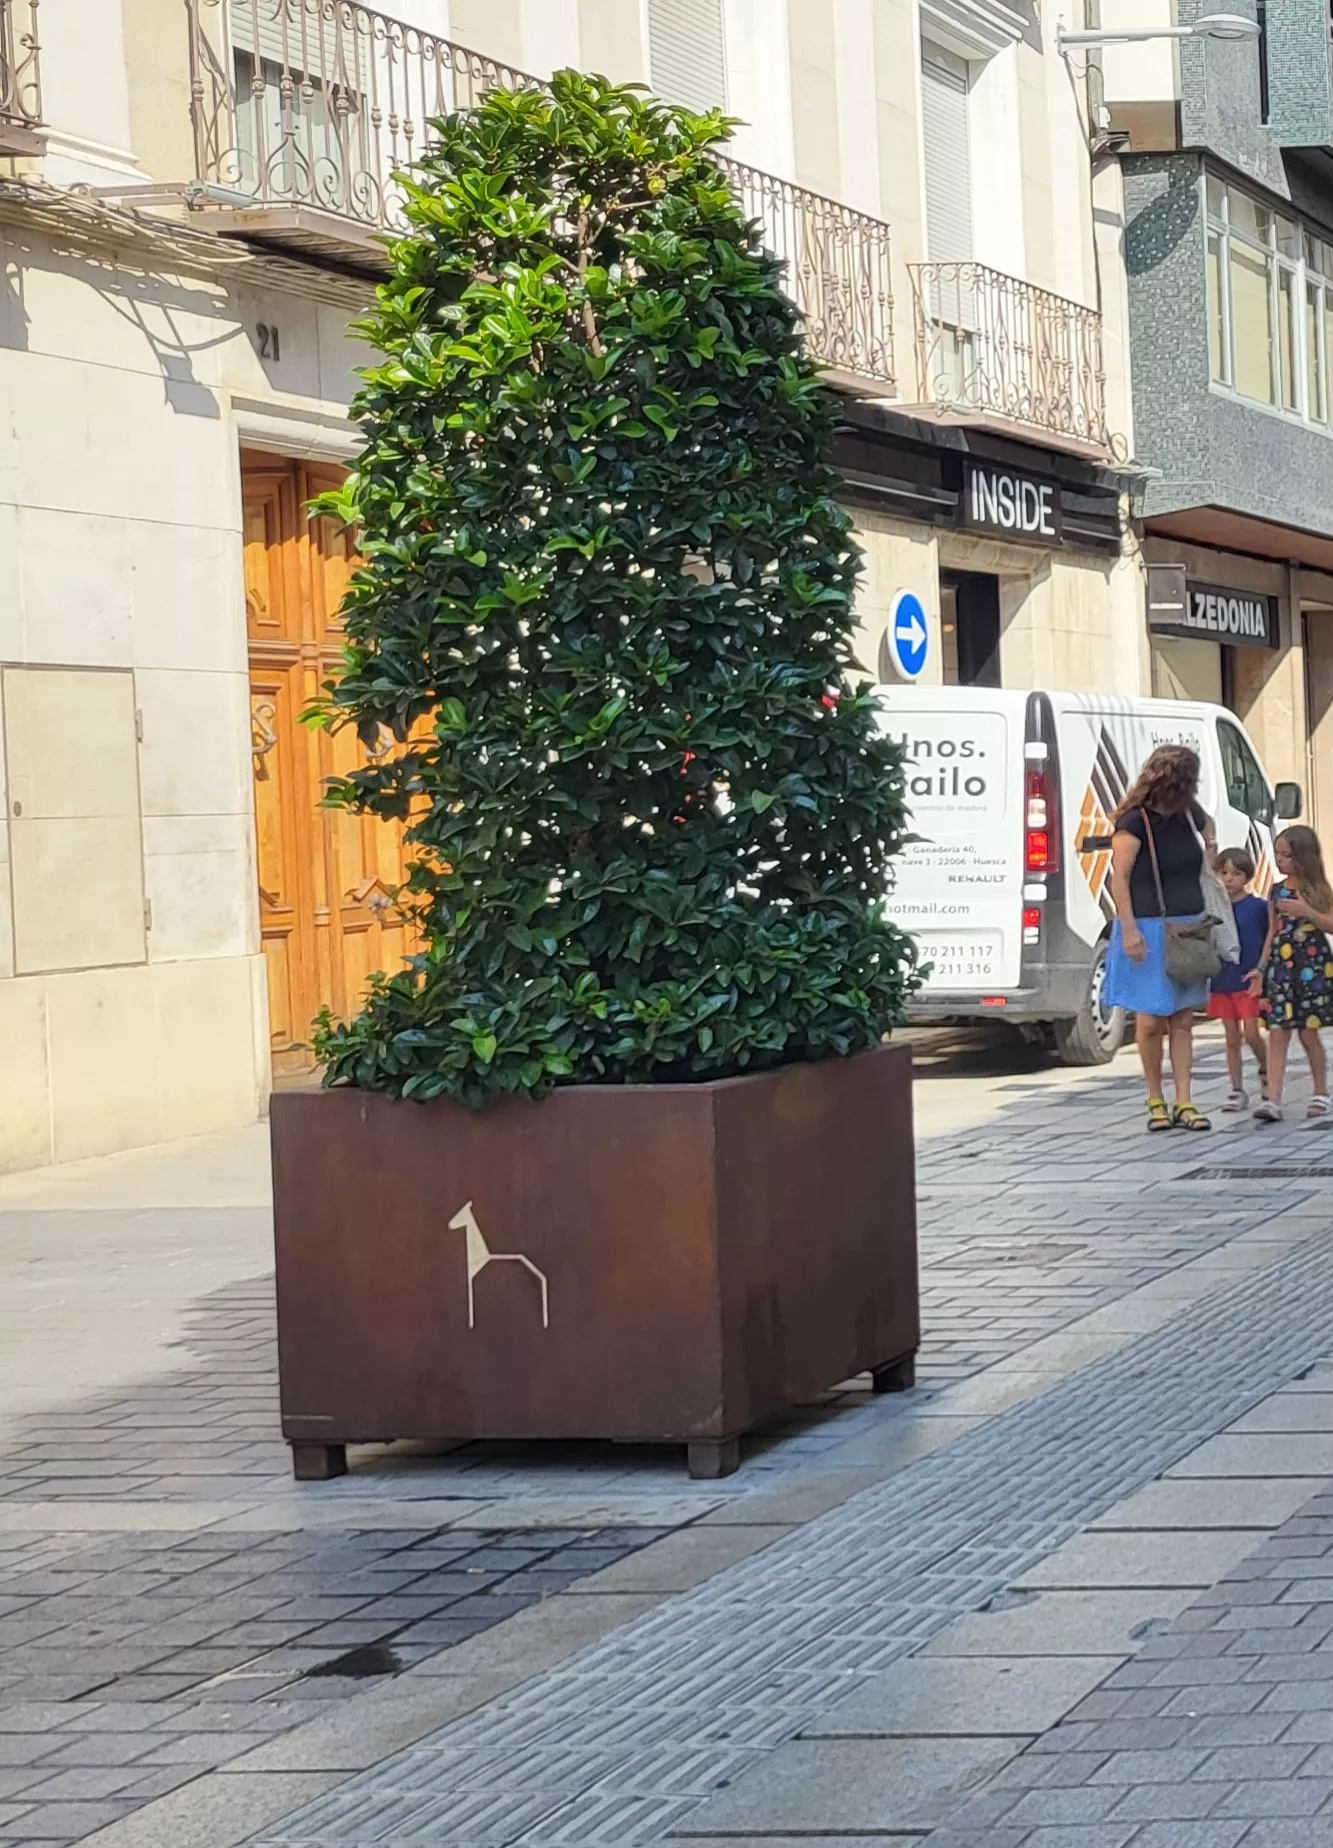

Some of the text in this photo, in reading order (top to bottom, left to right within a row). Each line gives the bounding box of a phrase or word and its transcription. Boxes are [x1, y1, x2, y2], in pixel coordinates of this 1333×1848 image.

[256, 321, 281, 362] 21
[971, 469, 1056, 536] INSIDE
[1182, 590, 1266, 638] LZEDONIA
[910, 766, 987, 797] ailo
[938, 857, 967, 866] 22006
[973, 858, 1007, 866] Huesca
[947, 874, 1008, 883] RENAULT
[922, 945, 993, 957] 70 211 117
[939, 962, 992, 975] 211 316
